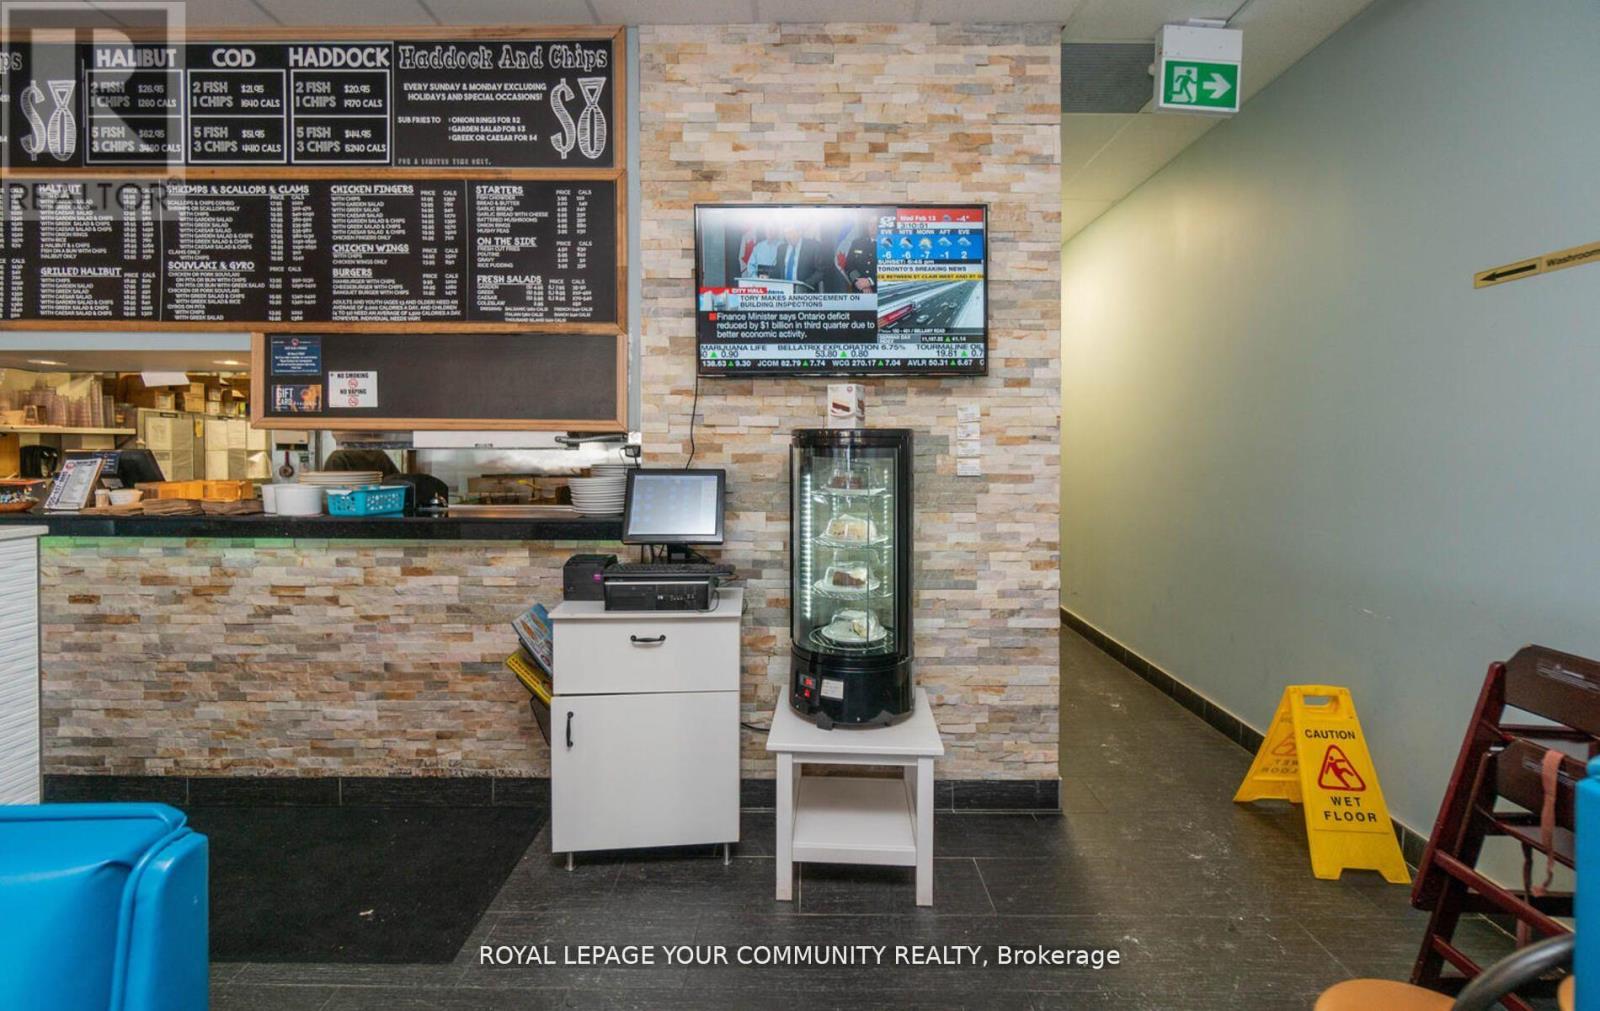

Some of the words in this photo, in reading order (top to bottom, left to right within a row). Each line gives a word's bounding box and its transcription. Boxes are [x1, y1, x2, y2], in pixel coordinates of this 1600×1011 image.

[96, 48, 176, 67] HALIBUT
[212, 48, 256, 67] COD
[289, 47, 389, 68] HADDOCK
[399, 46, 493, 69] Haddock
[498, 45, 544, 69] And
[549, 43, 606, 71] Chips
[91, 82, 98, 93] 2
[100, 82, 124, 93] FISH
[193, 82, 200, 93] 2
[204, 82, 227, 93] FISH
[296, 81, 303, 93] 2
[306, 81, 330, 93] FISH
[345, 85, 370, 93] $20.95
[404, 83, 428, 91] EVERY
[430, 83, 460, 91] SUNDAY
[469, 83, 502, 91] MONDAY
[504, 83, 546, 91] EXCLUDING
[91, 96, 96, 107] 1
[97, 96, 130, 107] CHIPS
[193, 96, 197, 107] 1
[200, 96, 233, 107] CHIPS
[296, 96, 300, 107] 1
[303, 96, 336, 107] CHIPS
[408, 93, 446, 101] HOLIDAYS
[447, 93, 463, 101] AND
[464, 93, 494, 101] SPECIAL
[495, 93, 542, 101] OCCASIONS!
[158, 99, 177, 107] CALS
[261, 99, 280, 107] CALS
[363, 99, 382, 107] CALS
[93, 127, 98, 138] 5
[101, 127, 125, 138] FISH
[194, 127, 201, 138] 5
[204, 127, 228, 138] FISH
[297, 127, 304, 138] 5
[307, 127, 331, 138] FISH
[452, 125, 479, 133] GARDEN
[480, 125, 502, 133] SALAD
[503, 125, 516, 133] FOR
[452, 134, 474, 142] GREEK
[475, 134, 485, 142] OR
[487, 134, 512, 142] CAESAR
[514, 134, 527, 142] FOR
[93, 141, 99, 152] 3
[102, 141, 135, 152] CHIPS
[161, 144, 182, 152] CALS
[194, 141, 201, 152] 3
[204, 141, 238, 152] CHIPS
[262, 144, 281, 152] CALS
[297, 141, 304, 152] 3
[307, 141, 340, 152] CHIPS
[367, 144, 386, 152] CALS
[166, 184, 208, 194] SHRIMPS
[220, 184, 266, 194] SCALLOPS
[279, 184, 309, 194] CLAMS
[331, 185, 371, 194] CHICKEN
[374, 185, 413, 194] FINGERS
[476, 186, 523, 195] STARTERS
[477, 238, 491, 246] ON
[494, 238, 512, 246] THE
[514, 238, 537, 246] SIDE
[333, 244, 373, 253] CHICKEN
[375, 244, 408, 253] WINGS
[168, 261, 217, 270] SOUVLAKI
[230, 261, 254, 270] GYRO
[41, 267, 78, 276] GRILLED
[81, 267, 121, 276] HALIBUT
[333, 268, 372, 277] BURGERS
[477, 275, 504, 283] FRESH
[507, 275, 542, 283] SALADS
[717, 312, 746, 321] Finance
[748, 312, 777, 321] Minister
[779, 312, 796, 321] says
[798, 312, 825, 321] Ontario
[827, 312, 850, 321] deficit
[717, 321, 747, 331] reduced
[749, 321, 758, 331] by
[760, 321, 769, 331] $1
[771, 321, 793, 331] billion
[795, 321, 802, 331] in
[804, 321, 821, 331] third
[823, 321, 849, 331] quarter
[851, 321, 865, 331] due
[867, 321, 875, 331] to
[717, 331, 739, 340] better
[741, 331, 777, 340] economic
[779, 331, 807, 340] activity.
[276, 388, 294, 399] GIFT
[1304, 729, 1356, 740] CAUTION
[1330, 796, 1361, 807] WET
[1324, 811, 1377, 822] FLOOR
